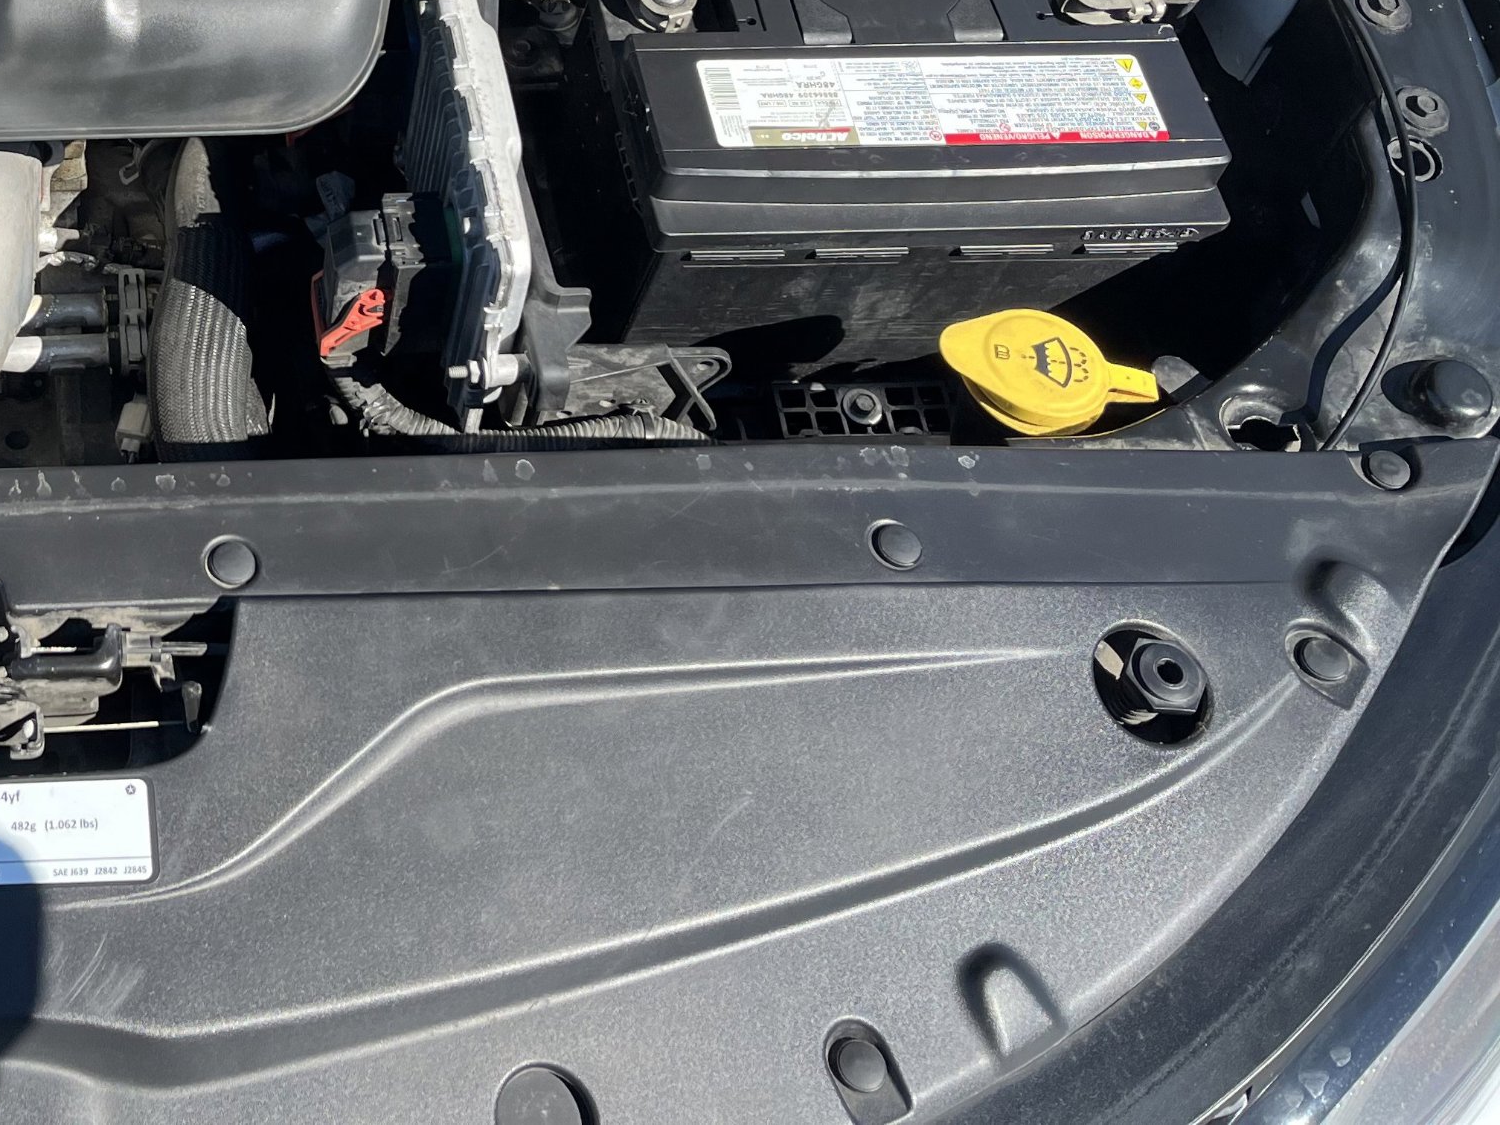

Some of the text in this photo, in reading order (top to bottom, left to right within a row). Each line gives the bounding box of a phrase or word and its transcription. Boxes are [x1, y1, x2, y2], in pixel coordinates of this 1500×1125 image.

[782, 132, 848, 142] ACDelco
[11, 818, 99, 832] 482g (1.062 lbs)
[53, 865, 147, 877] SAE J639 J2842 J2845
